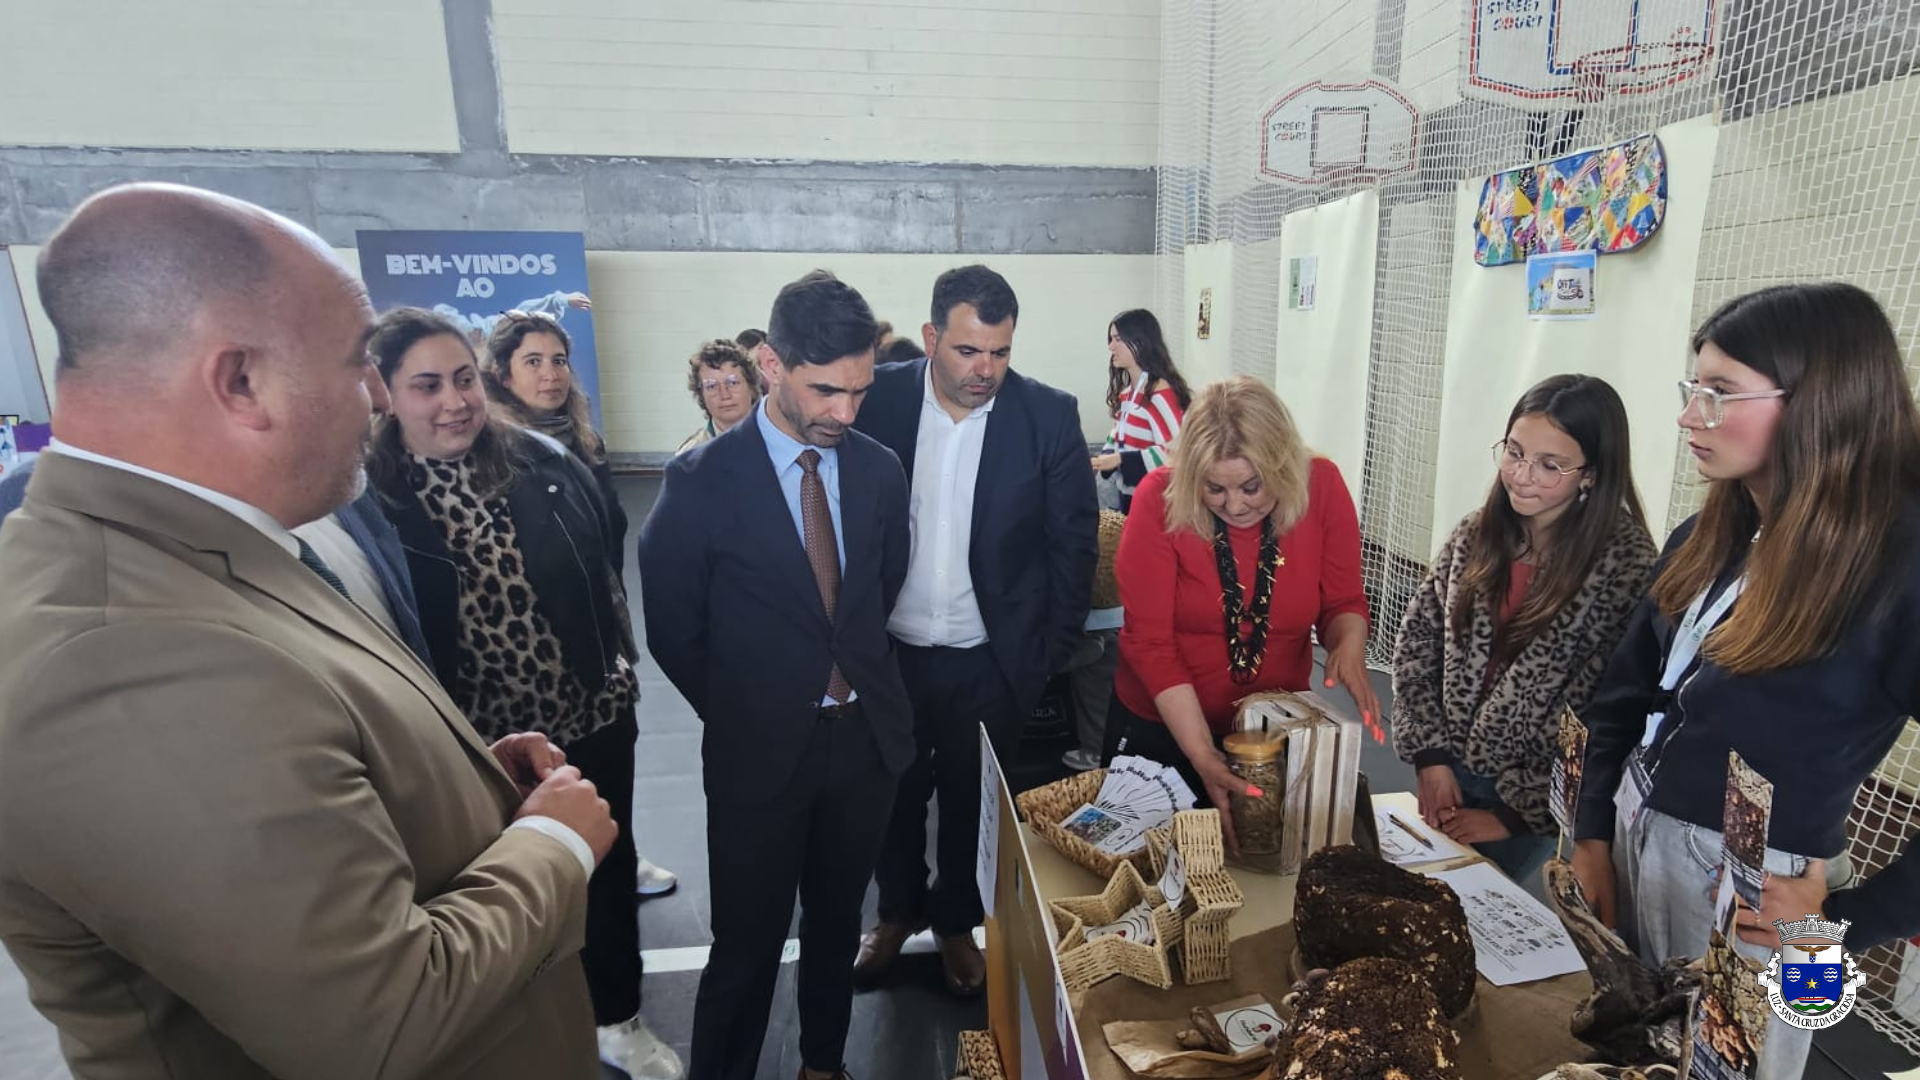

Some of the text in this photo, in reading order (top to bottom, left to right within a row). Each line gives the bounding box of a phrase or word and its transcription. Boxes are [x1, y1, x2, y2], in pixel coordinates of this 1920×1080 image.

[1487, 0, 1540, 13] STREET
[1493, 14, 1543, 31] COURT
[1272, 121, 1306, 131] STREET
[1275, 132, 1307, 141] COURT
[385, 253, 557, 275] BEM-VINDOS
[456, 277, 495, 298] AO
